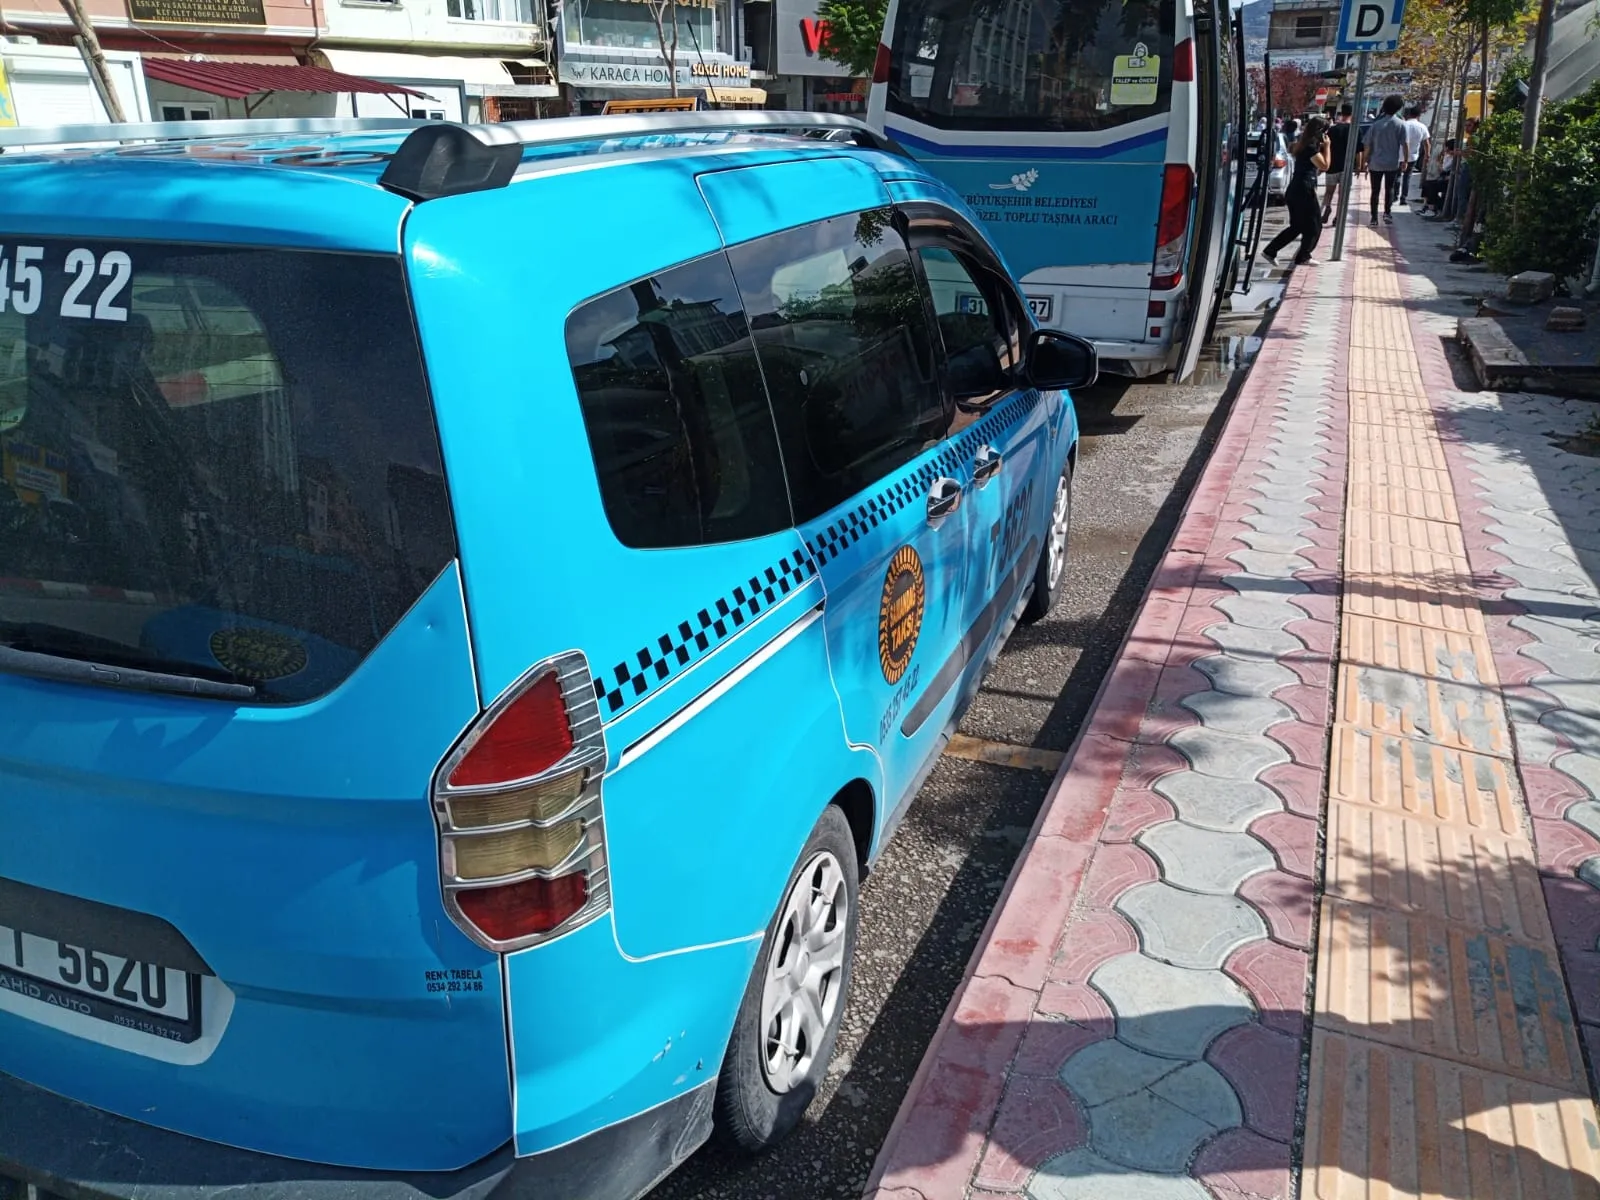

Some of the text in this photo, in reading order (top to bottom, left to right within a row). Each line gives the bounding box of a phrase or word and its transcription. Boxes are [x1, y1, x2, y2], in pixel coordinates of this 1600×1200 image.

[1355, 4, 1384, 37] D
[590, 67, 640, 83] KARACA
[692, 61, 749, 78] SÜSLÜ HOME
[967, 194, 1032, 209] BÜYÜKŞEHİR
[1035, 195, 1098, 209] BELEDİYESİ
[1004, 211, 1041, 223] TOPLU
[1042, 212, 1082, 227] TAŞIMA
[1083, 214, 1119, 226] ARACI
[60, 248, 132, 322] 22
[450, 969, 483, 979] TABELA
[46, 992, 92, 1014] AUTO
[113, 1014, 136, 1029] 0532
[170, 1030, 182, 1041] 72
